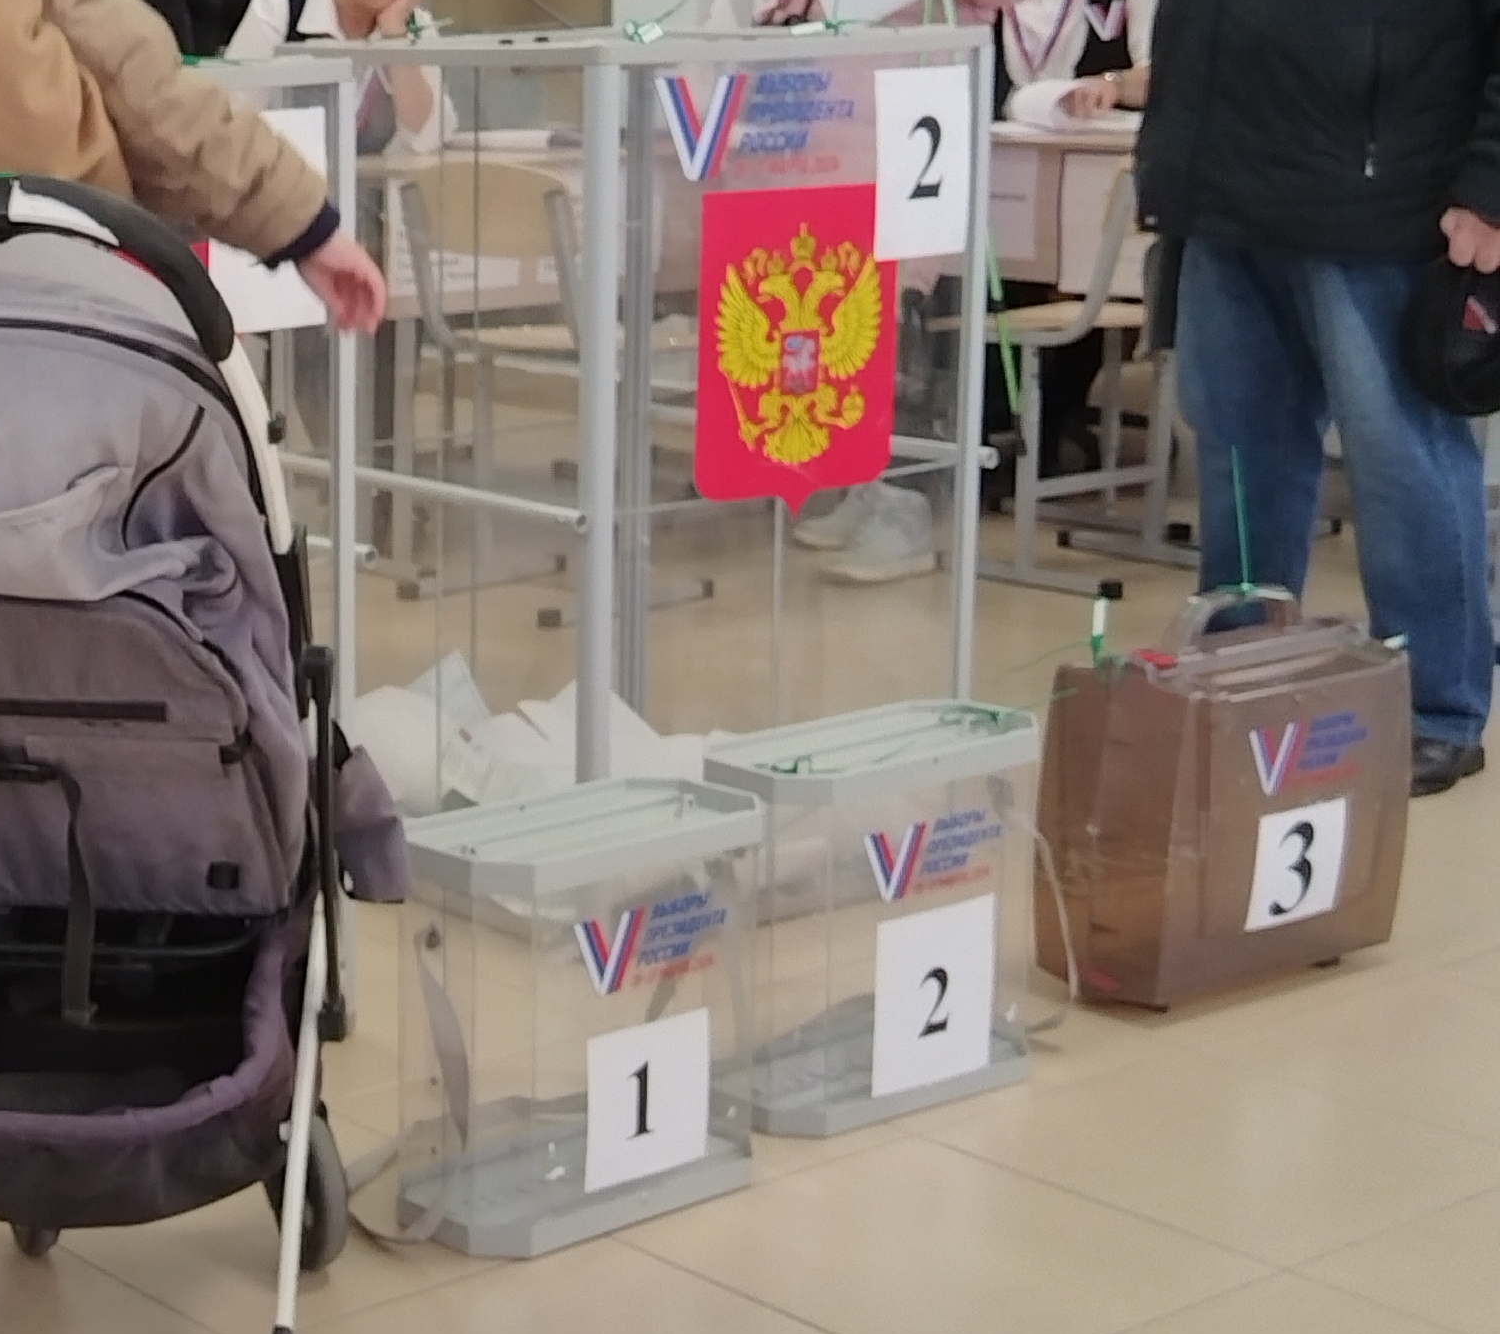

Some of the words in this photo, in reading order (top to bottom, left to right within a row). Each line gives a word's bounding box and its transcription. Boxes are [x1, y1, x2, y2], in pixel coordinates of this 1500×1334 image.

[905, 115, 944, 200] 2
[1268, 820, 1314, 917] 3
[918, 967, 950, 1039] 2
[627, 1060, 654, 1142] 1
